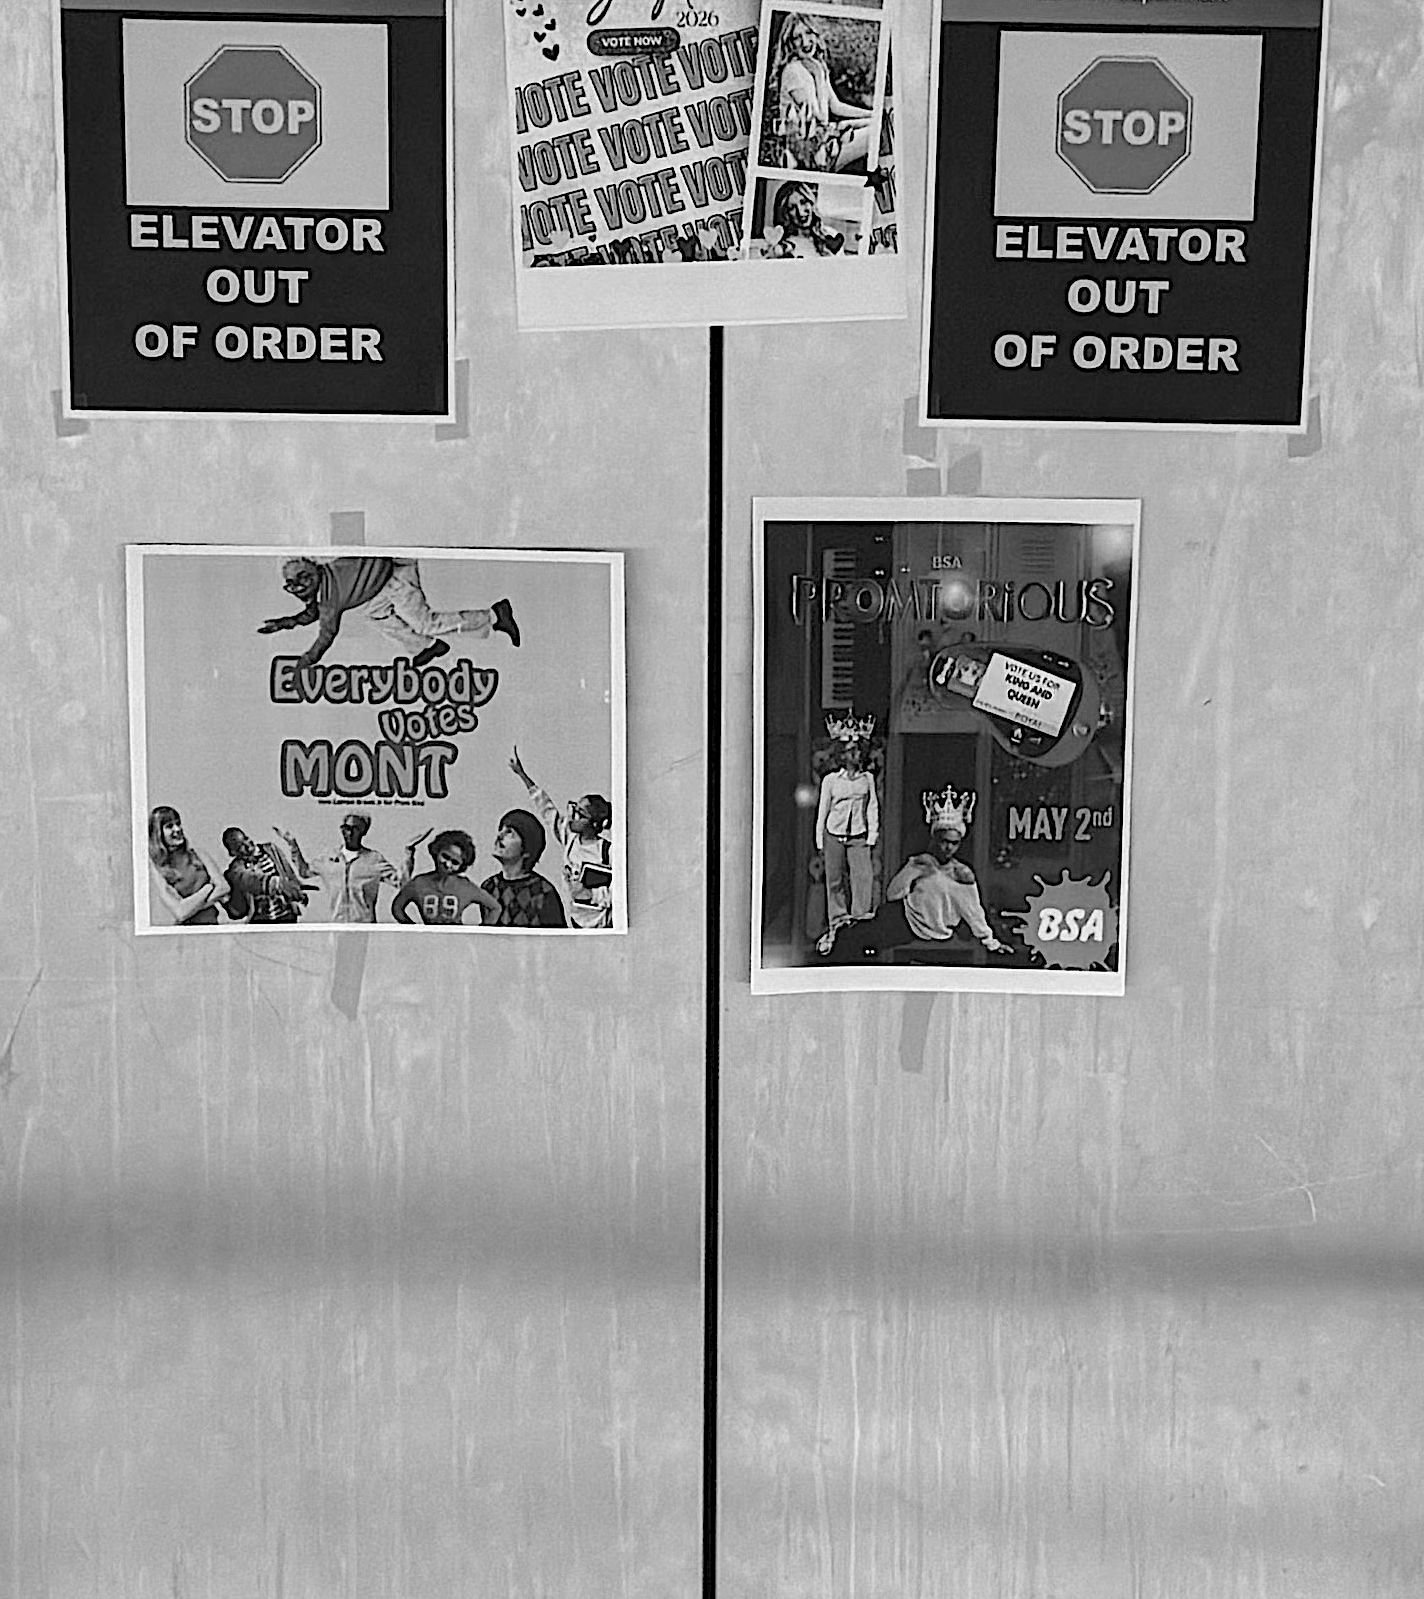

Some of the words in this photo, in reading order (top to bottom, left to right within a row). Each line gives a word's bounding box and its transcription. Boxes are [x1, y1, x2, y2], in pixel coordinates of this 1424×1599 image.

[675, 9, 721, 28] 2026
[600, 35, 633, 48] VOTE
[633, 34, 663, 48] NOW
[588, 52, 681, 123] VOTE
[191, 97, 316, 135] STOP
[597, 106, 690, 171] VOTE
[684, 86, 754, 148] VOT
[1062, 109, 1186, 146] STOP
[593, 167, 686, 230] VOTE
[680, 147, 748, 208] VOT
[129, 213, 385, 252] ELEVATOR
[995, 224, 1247, 263] ELEVATOR
[205, 268, 310, 304] OUT
[1067, 278, 1170, 315] OUT
[134, 323, 199, 359] OF
[214, 325, 384, 362] ORDER
[993, 333, 1058, 369] OF
[1072, 334, 1240, 372] ORDER
[931, 555, 964, 570] BSA
[271, 656, 498, 707] Everybody
[378, 707, 478, 743] Votes
[281, 739, 459, 798] MONT
[1008, 806, 1069, 841] MAY
[1075, 806, 1113, 841] 2nd
[1037, 907, 1104, 942] BSA
